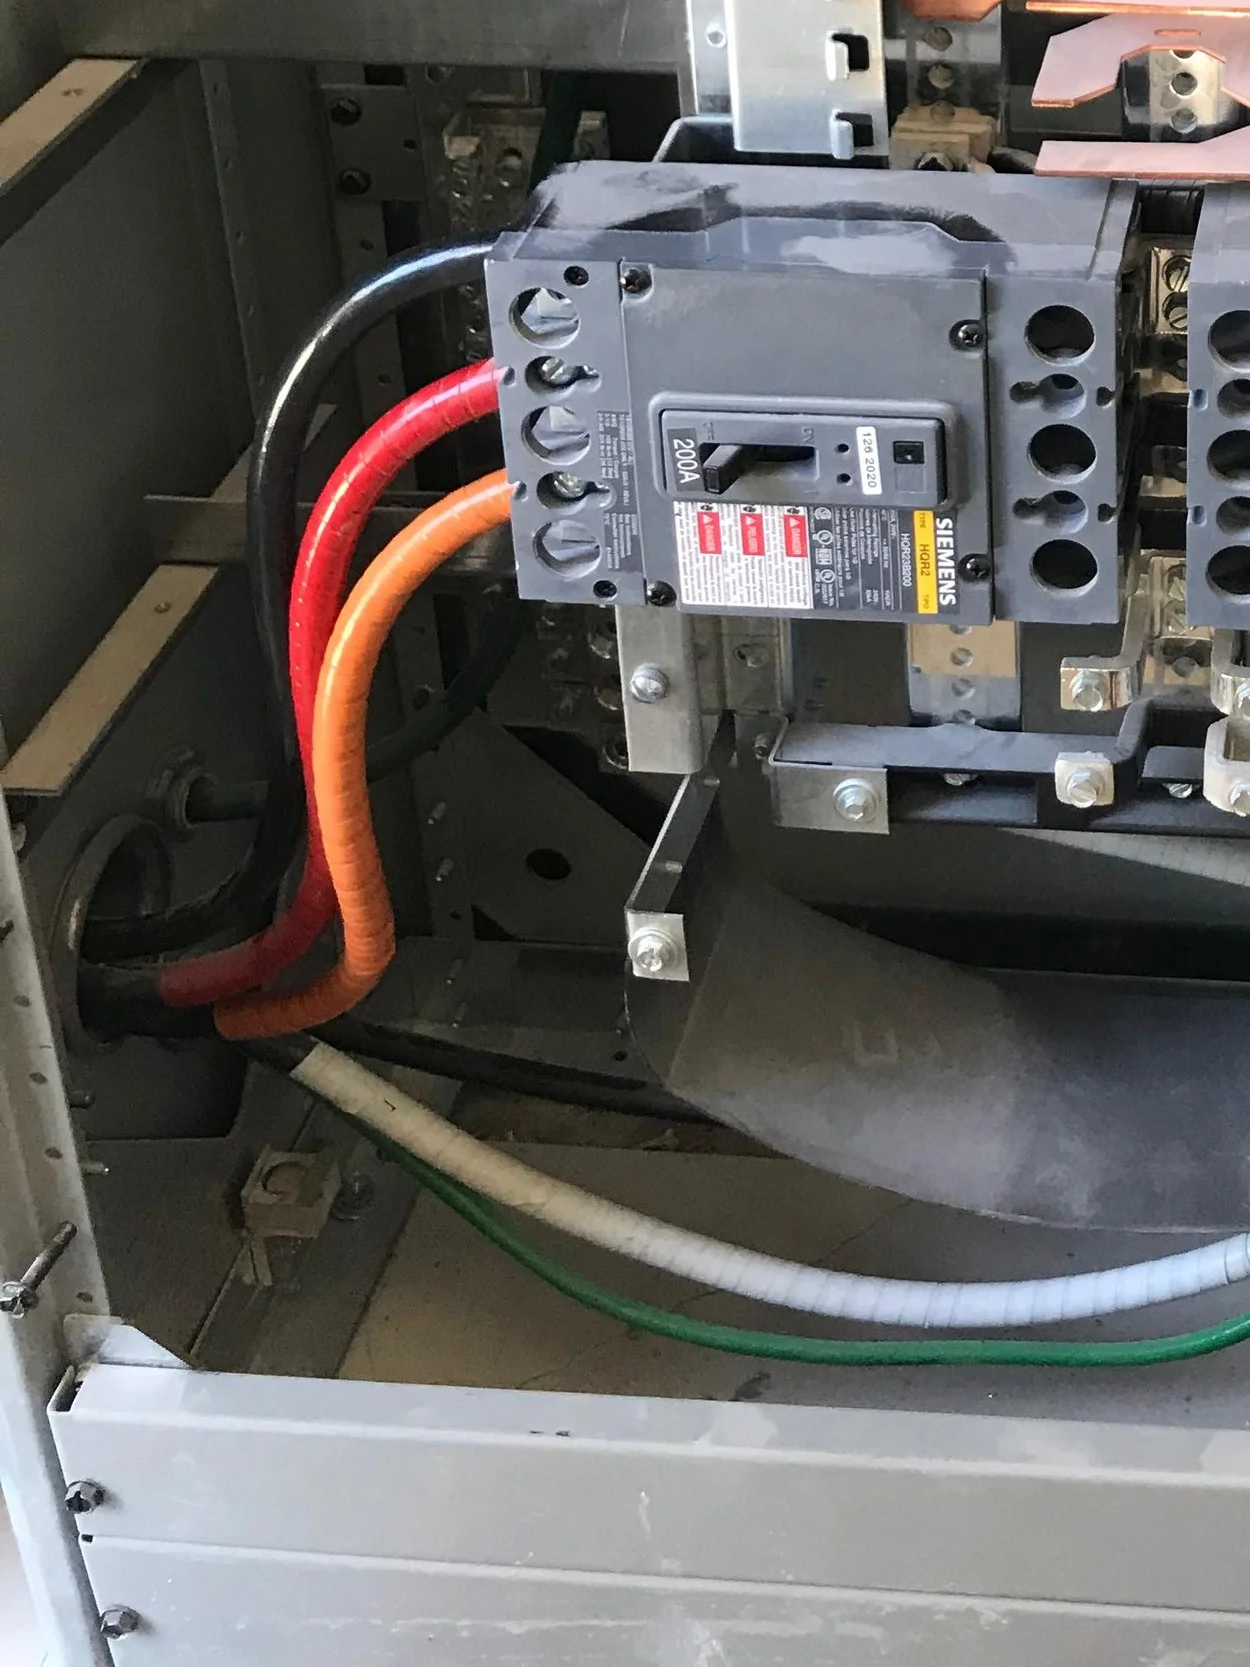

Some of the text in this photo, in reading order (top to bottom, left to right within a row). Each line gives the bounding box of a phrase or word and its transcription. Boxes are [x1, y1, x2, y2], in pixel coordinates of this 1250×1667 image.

[673, 438, 700, 484] 200A
[861, 431, 877, 488] 126 2020
[901, 533, 913, 587] HQR23B200
[919, 543, 930, 577] HQR2
[935, 517, 957, 606] SIEMENS
